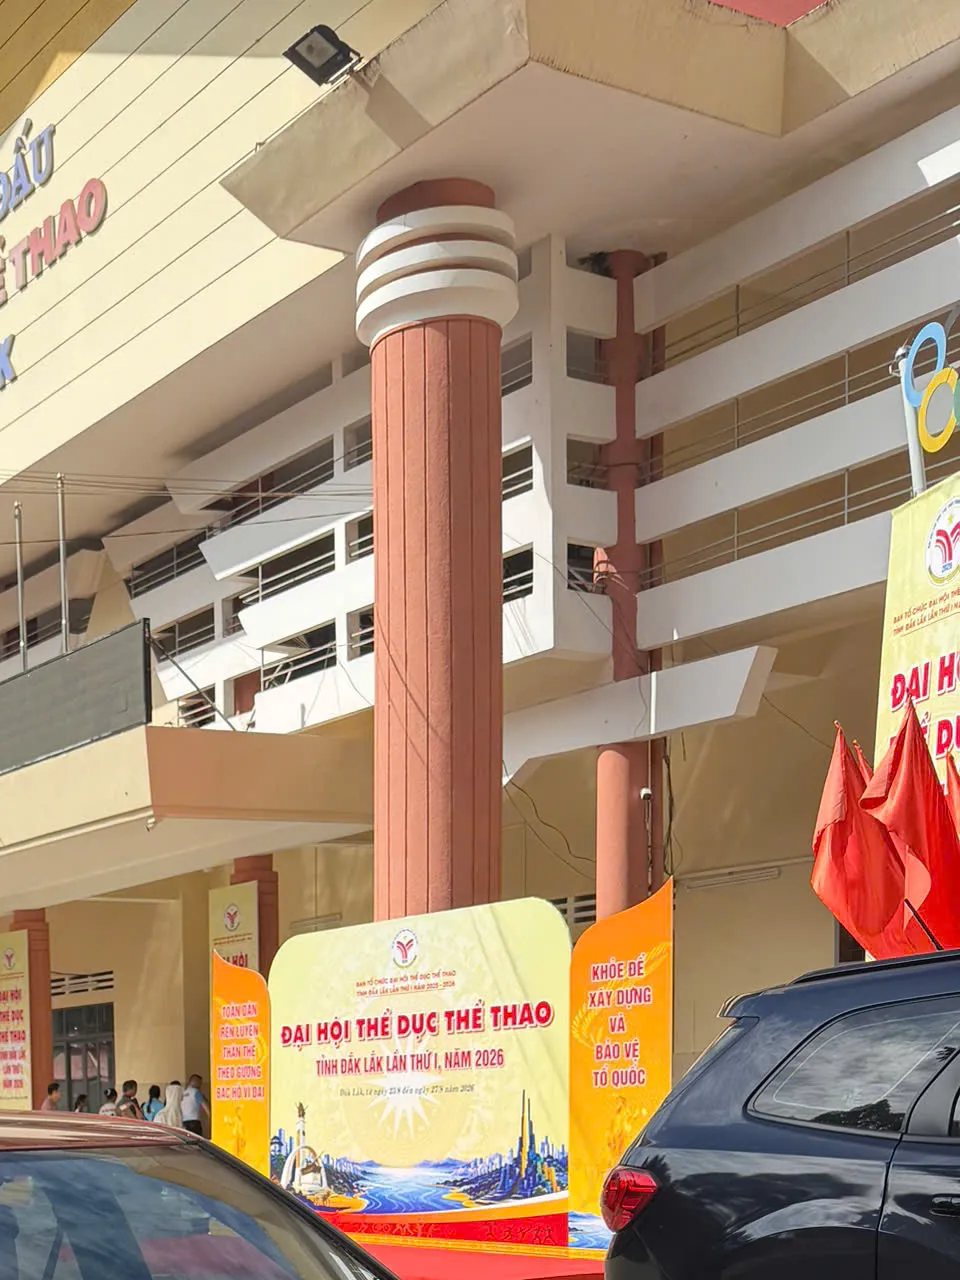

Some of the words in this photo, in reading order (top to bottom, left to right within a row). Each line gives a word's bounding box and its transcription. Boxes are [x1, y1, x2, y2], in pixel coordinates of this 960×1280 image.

[9, 177, 108, 291] THAO
[592, 958, 624, 980] KHỎE
[628, 953, 645, 977] ĐỂ
[589, 987, 612, 1008] XÂY
[616, 986, 652, 1009] DỰNG
[281, 1023, 312, 1050] ĐẠI
[317, 1016, 351, 1048] HỘI
[356, 1008, 392, 1040] THỂ
[397, 1012, 439, 1042] DỤC
[444, 999, 485, 1034] THỂ
[490, 1001, 555, 1030] THAO
[609, 1013, 625, 1032] VÀ
[316, 1054, 338, 1076] TỈNH
[341, 1052, 361, 1075] ĐẮK
[364, 1050, 383, 1073] LẮK
[386, 1049, 407, 1072] LẦN
[409, 1049, 433, 1071] THỨ
[434, 1052, 442, 1072] I,
[444, 1048, 472, 1069] NĂM
[475, 1048, 504, 1068] 2026
[595, 1039, 620, 1060] BẢO
[624, 1039, 640, 1062] VỆ
[593, 1064, 608, 1086] TỔ
[611, 1063, 646, 1087] QUỐC
